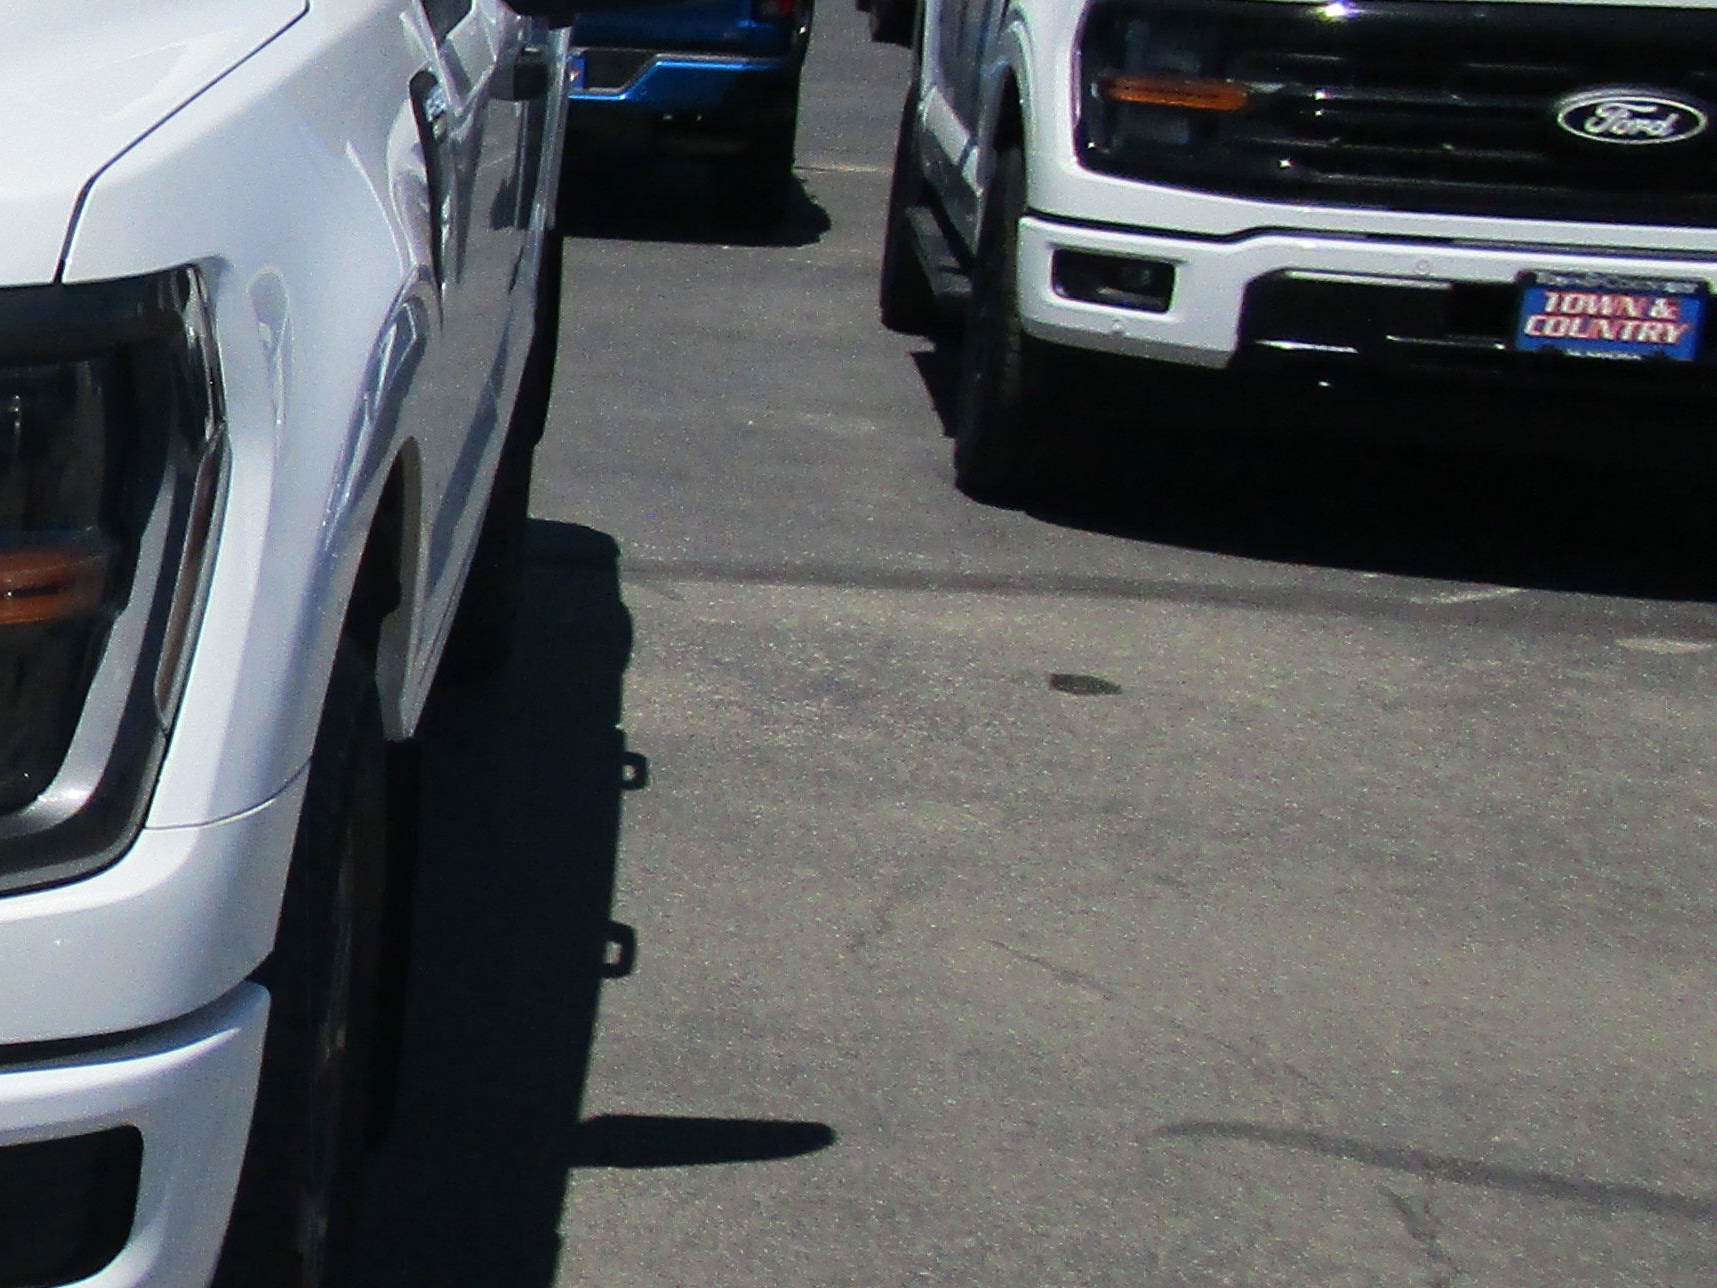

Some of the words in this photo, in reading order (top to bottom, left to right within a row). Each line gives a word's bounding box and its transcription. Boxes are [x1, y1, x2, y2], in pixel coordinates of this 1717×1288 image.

[1583, 102, 1680, 138] Ford
[1543, 290, 1648, 318] TOWN
[1648, 297, 1680, 320] &
[1523, 314, 1692, 345] COUNTRY
